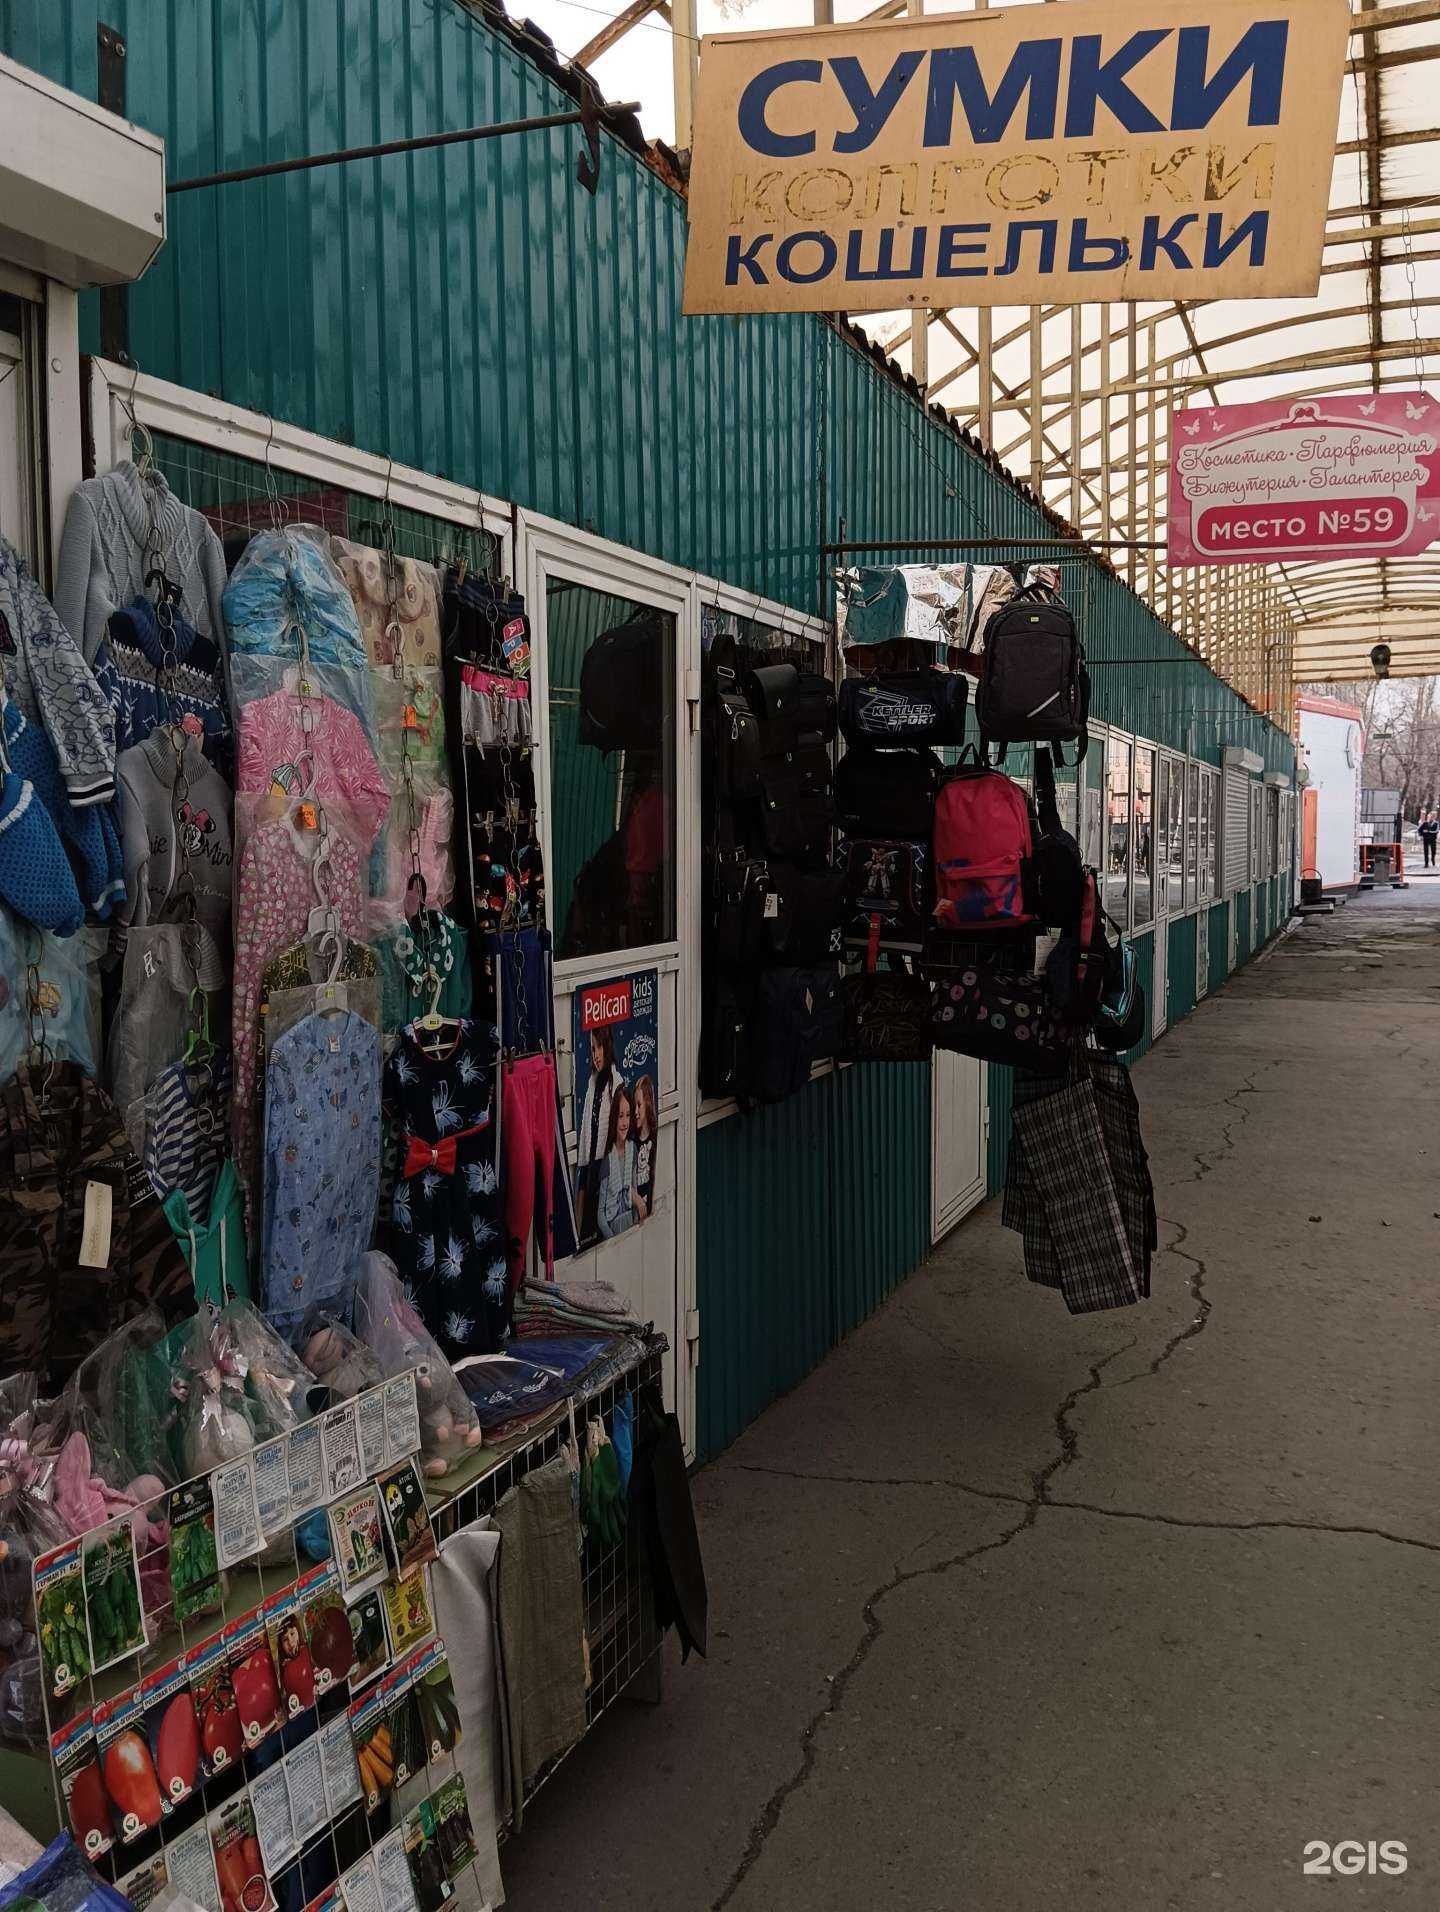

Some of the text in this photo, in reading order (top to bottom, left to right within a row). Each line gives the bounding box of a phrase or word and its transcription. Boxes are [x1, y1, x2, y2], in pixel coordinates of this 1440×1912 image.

[737, 19, 1289, 158] СУМКИ
[729, 141, 1276, 225] КОЛГОТКИ
[724, 210, 1270, 286] КОШЕЛЬКИ
[1181, 435, 1433, 471] Косметика Парфюмерия
[1185, 474, 1301, 504] Бижутерия
[1318, 507, 1395, 535] №59
[887, 713, 937, 725] SPORT
[633, 976, 653, 1000] kids
[584, 993, 628, 1025] Pelican
